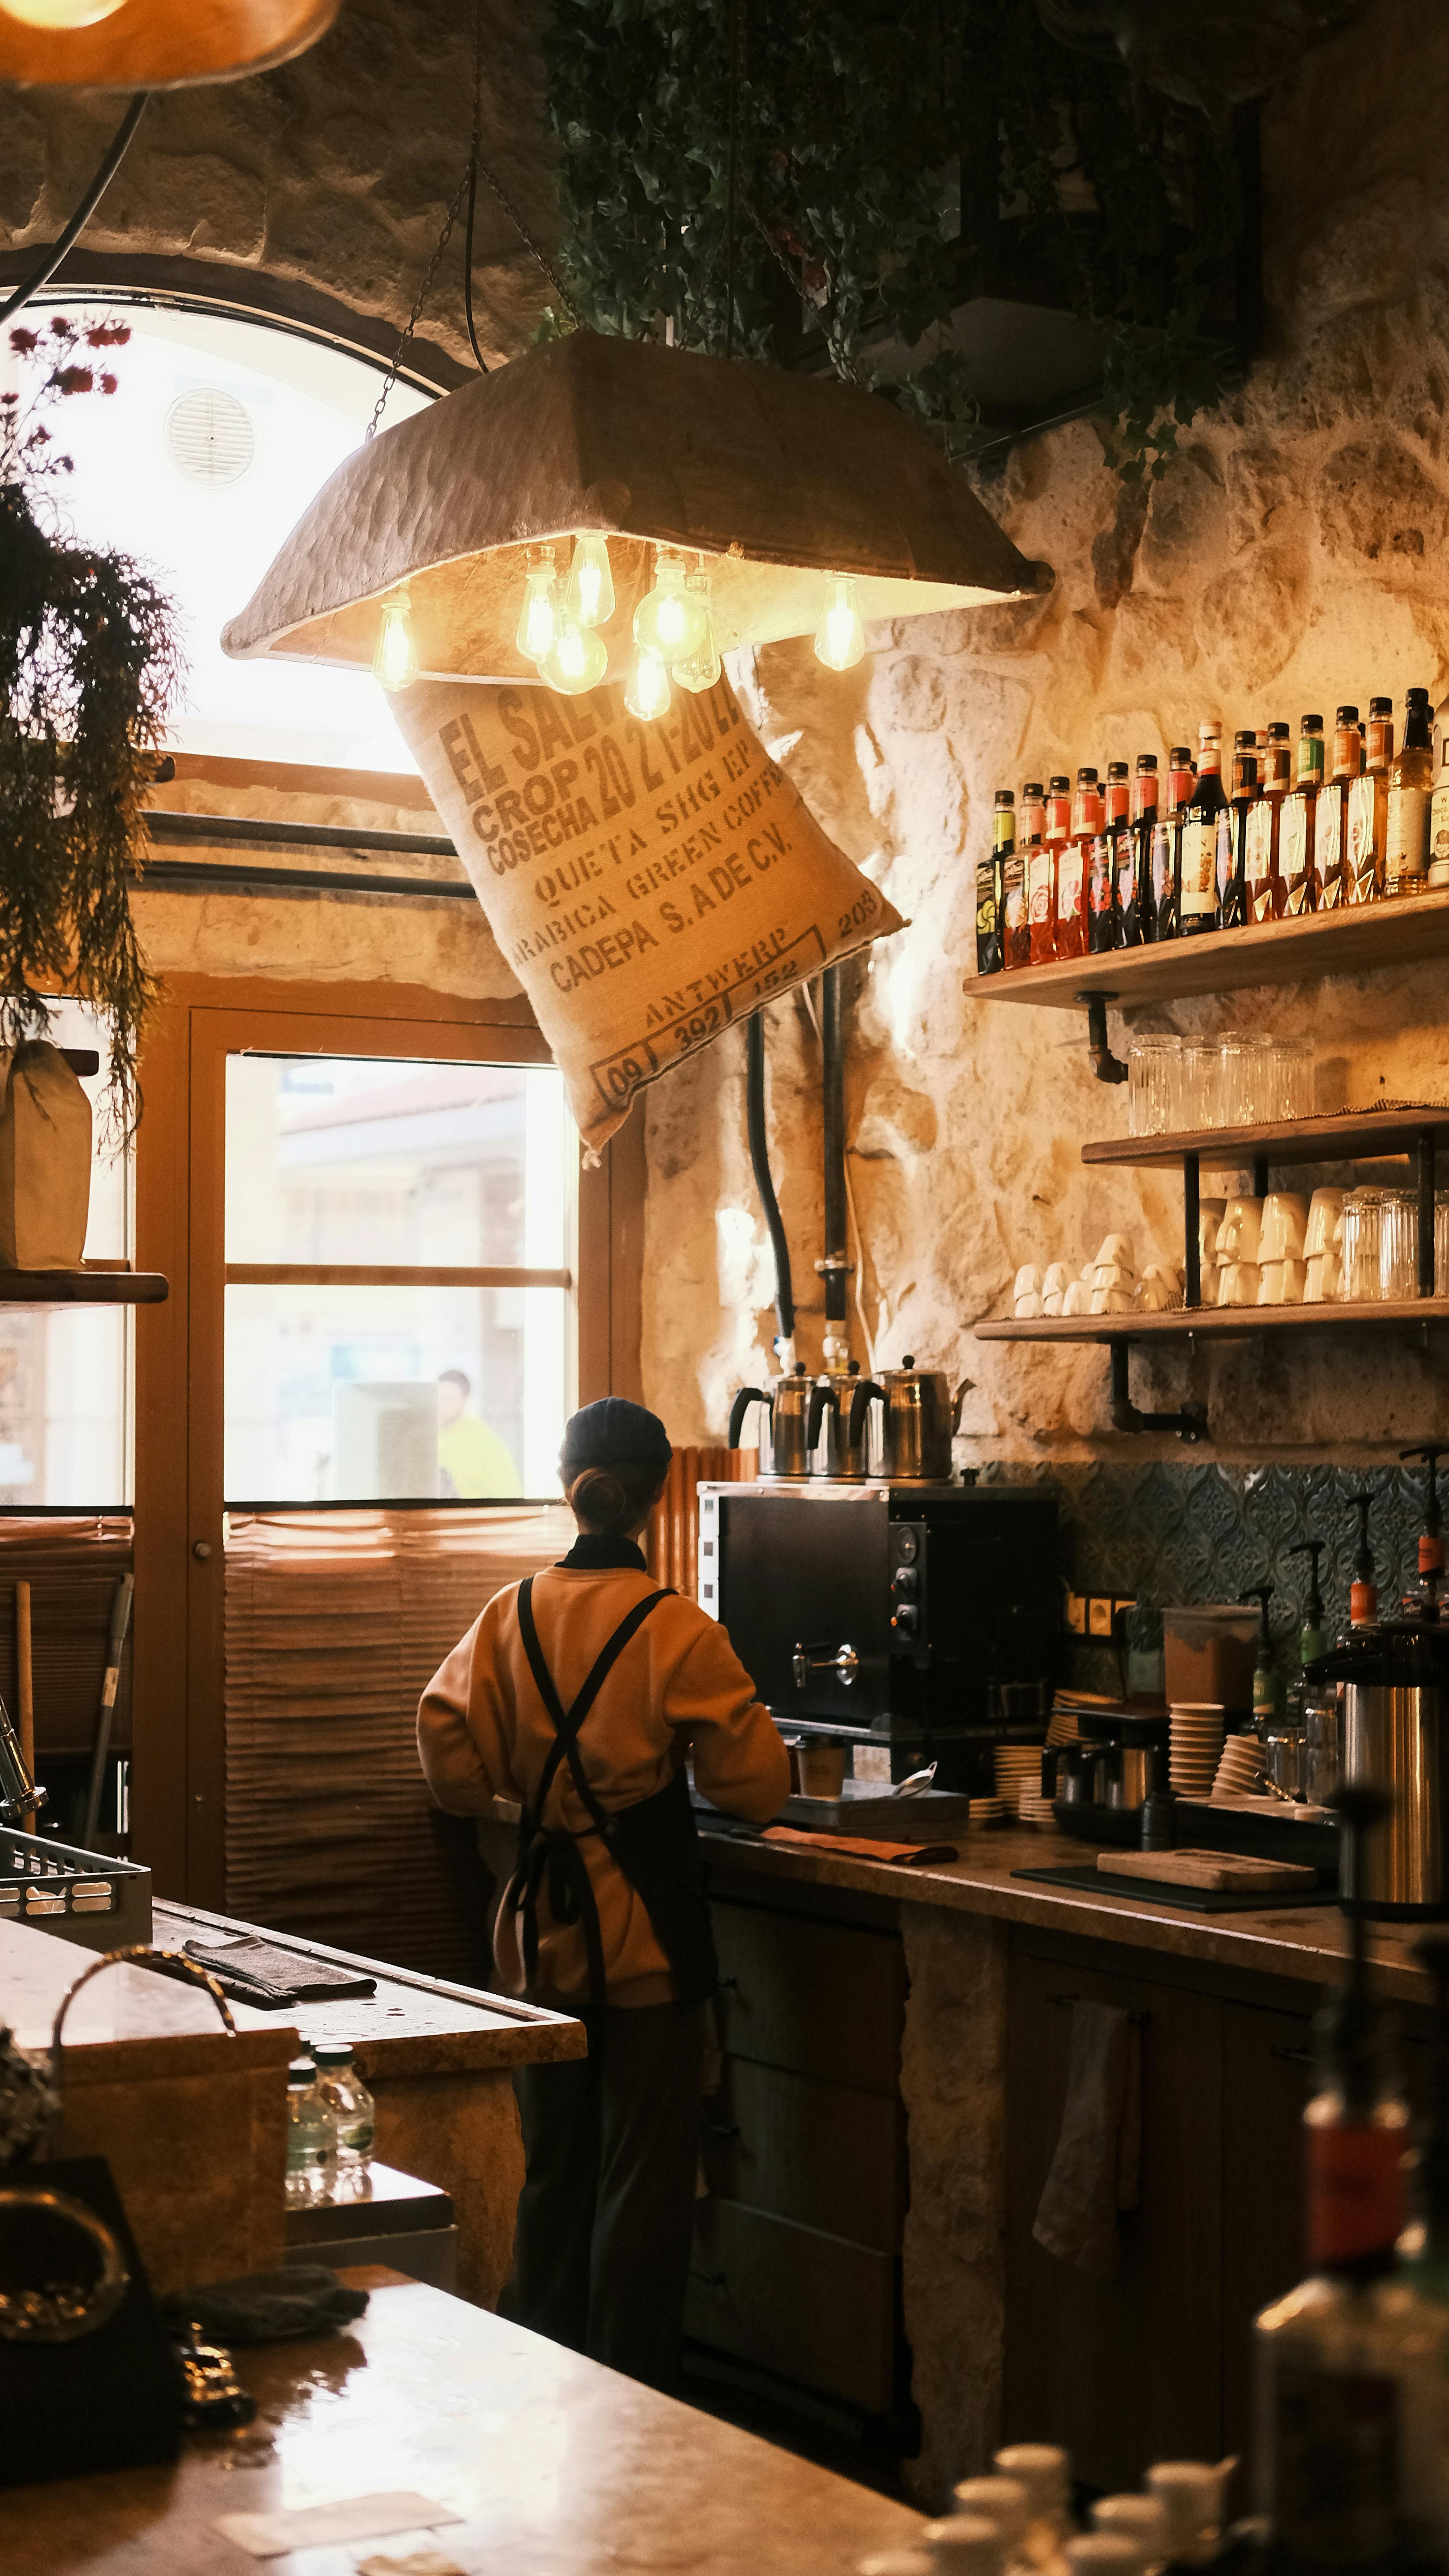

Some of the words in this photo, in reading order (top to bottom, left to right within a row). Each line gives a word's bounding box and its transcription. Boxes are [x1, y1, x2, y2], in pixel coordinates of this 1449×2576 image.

[439, 713, 508, 806] EL
[471, 758, 579, 843] CROP
[487, 796, 599, 876] COSECHA
[626, 821, 722, 900] GREEN
[550, 920, 660, 992] CADEPA
[747, 822, 793, 871] C.V.
[644, 927, 786, 1028] ANTWERP
[607, 1057, 643, 1096] 09
